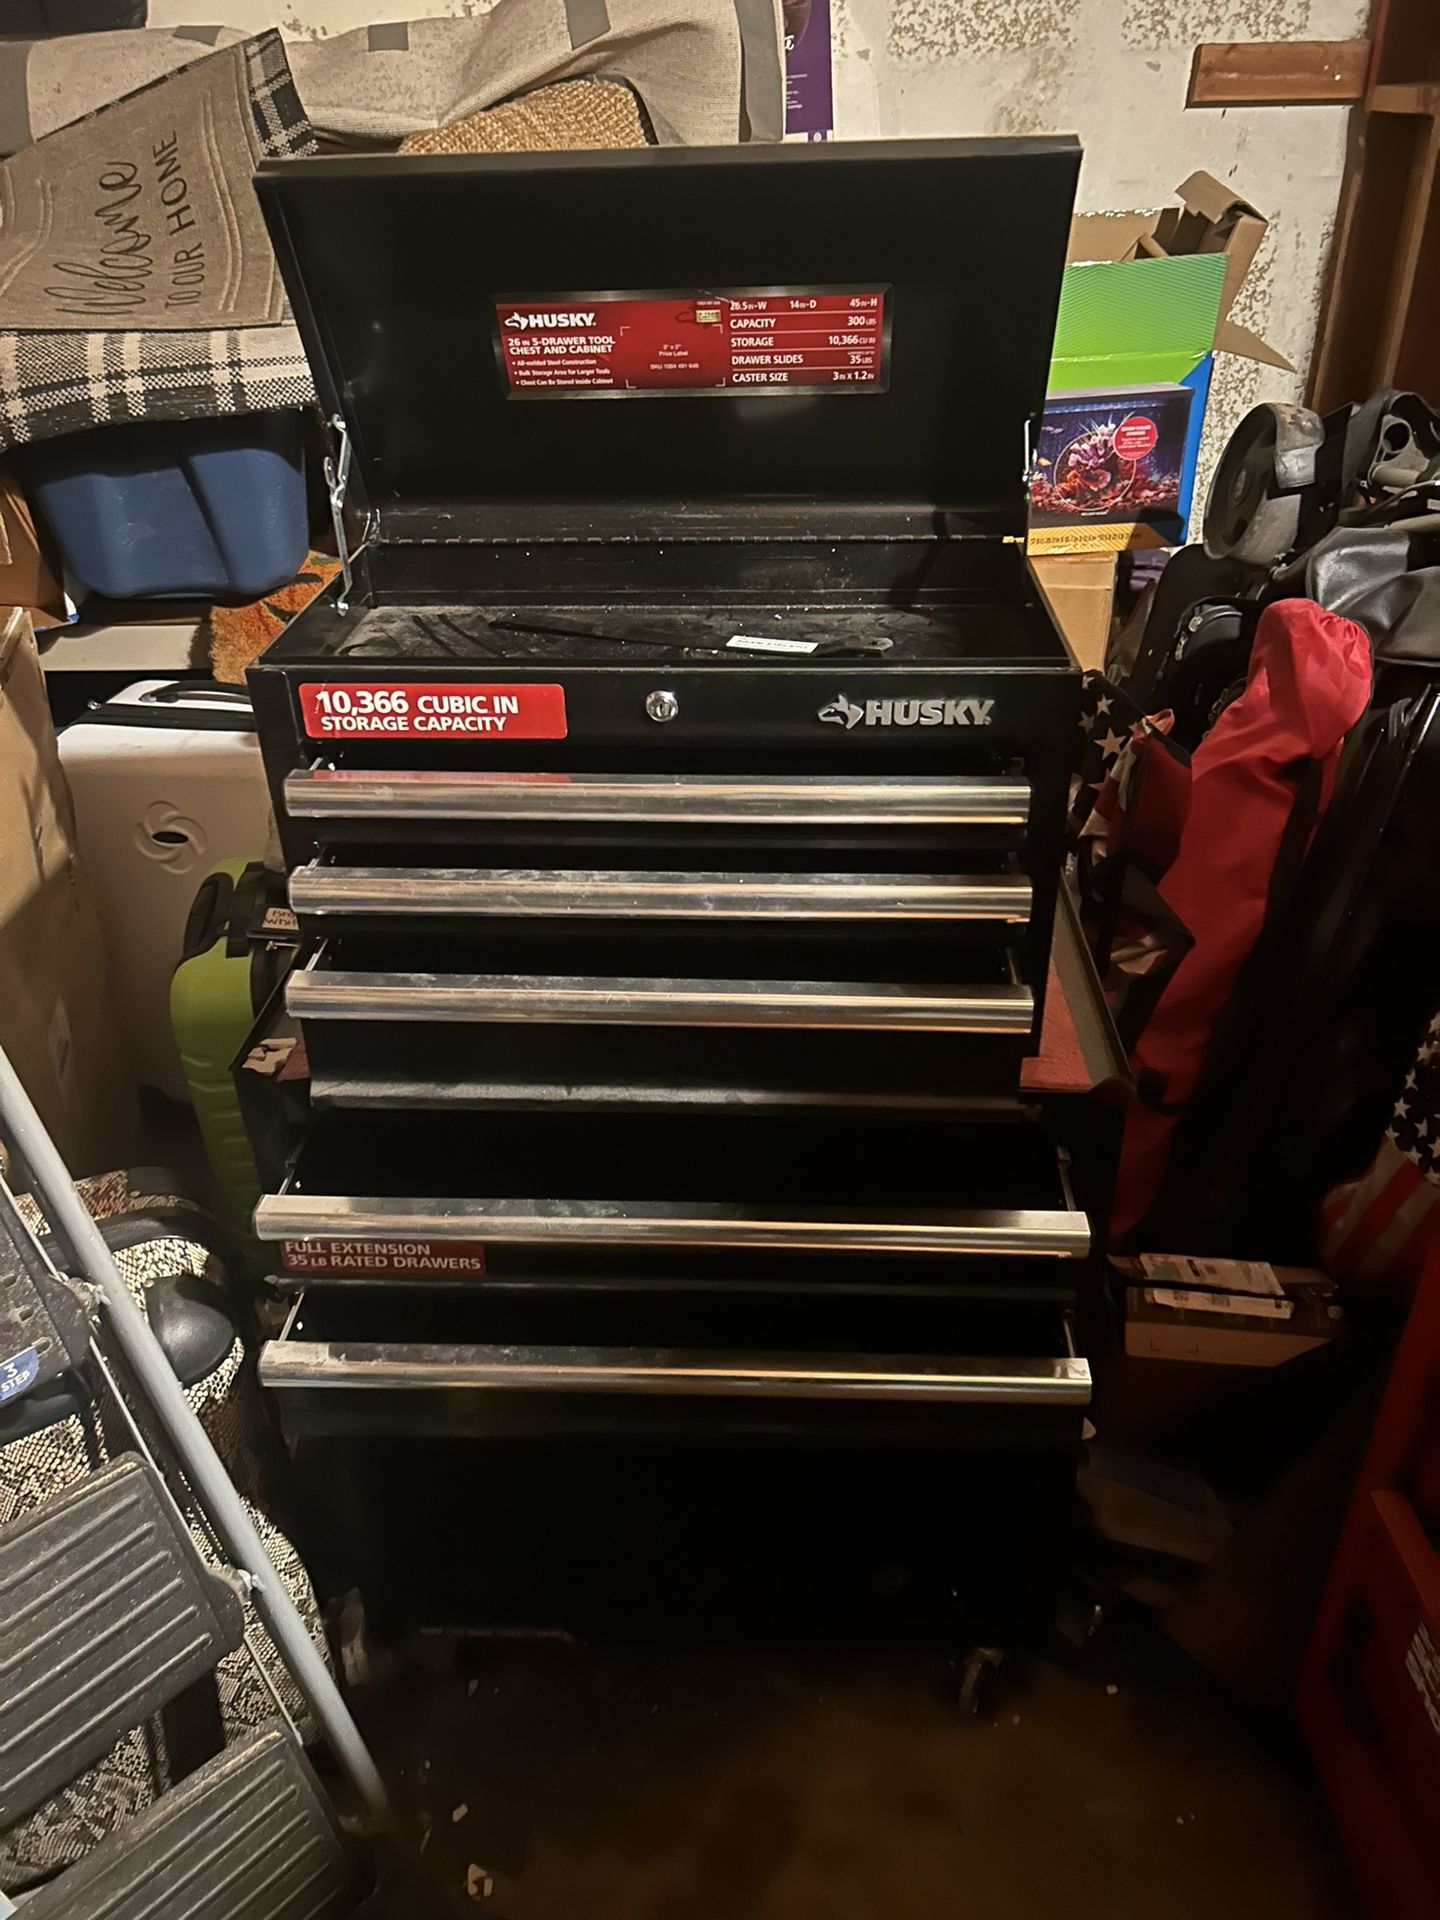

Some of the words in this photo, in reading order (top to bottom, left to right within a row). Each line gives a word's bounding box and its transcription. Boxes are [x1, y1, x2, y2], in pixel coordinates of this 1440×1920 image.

[152, 130, 196, 236] HOME
[172, 242, 205, 286] OUR
[164, 290, 202, 309] TO
[528, 313, 596, 328] HUSKY
[730, 318, 776, 328] CAPACITY
[848, 316, 865, 326] 300
[508, 338, 520, 347] 26
[532, 337, 587, 346] 5-DRAWER
[588, 336, 616, 345] TOOL
[731, 337, 775, 347] STORAGE
[828, 335, 859, 346] 10,366
[509, 346, 541, 355] CHEST
[543, 346, 567, 354] AND
[569, 345, 613, 354] CABINET
[732, 355, 771, 365] DRAWER
[773, 354, 803, 364] SLIDES
[850, 355, 861, 364] 35
[732, 373, 767, 383] CASTER
[769, 372, 788, 382] SIZE
[316, 691, 409, 716] 10,366
[417, 696, 488, 714] CUBIC
[493, 696, 519, 714] IN
[865, 699, 995, 725] HUSKY
[321, 716, 409, 731] STORAGE
[414, 716, 506, 731] CAPACITY
[285, 1241, 327, 1253] FULL
[331, 1242, 430, 1256] EXTENSION
[288, 1254, 308, 1266] 35
[311, 1258, 327, 1266] LB
[331, 1255, 388, 1268] RATED
[394, 1256, 481, 1269] DRAWERS
[3, 1362, 18, 1378] 3
[1, 1370, 30, 1392] STEP
